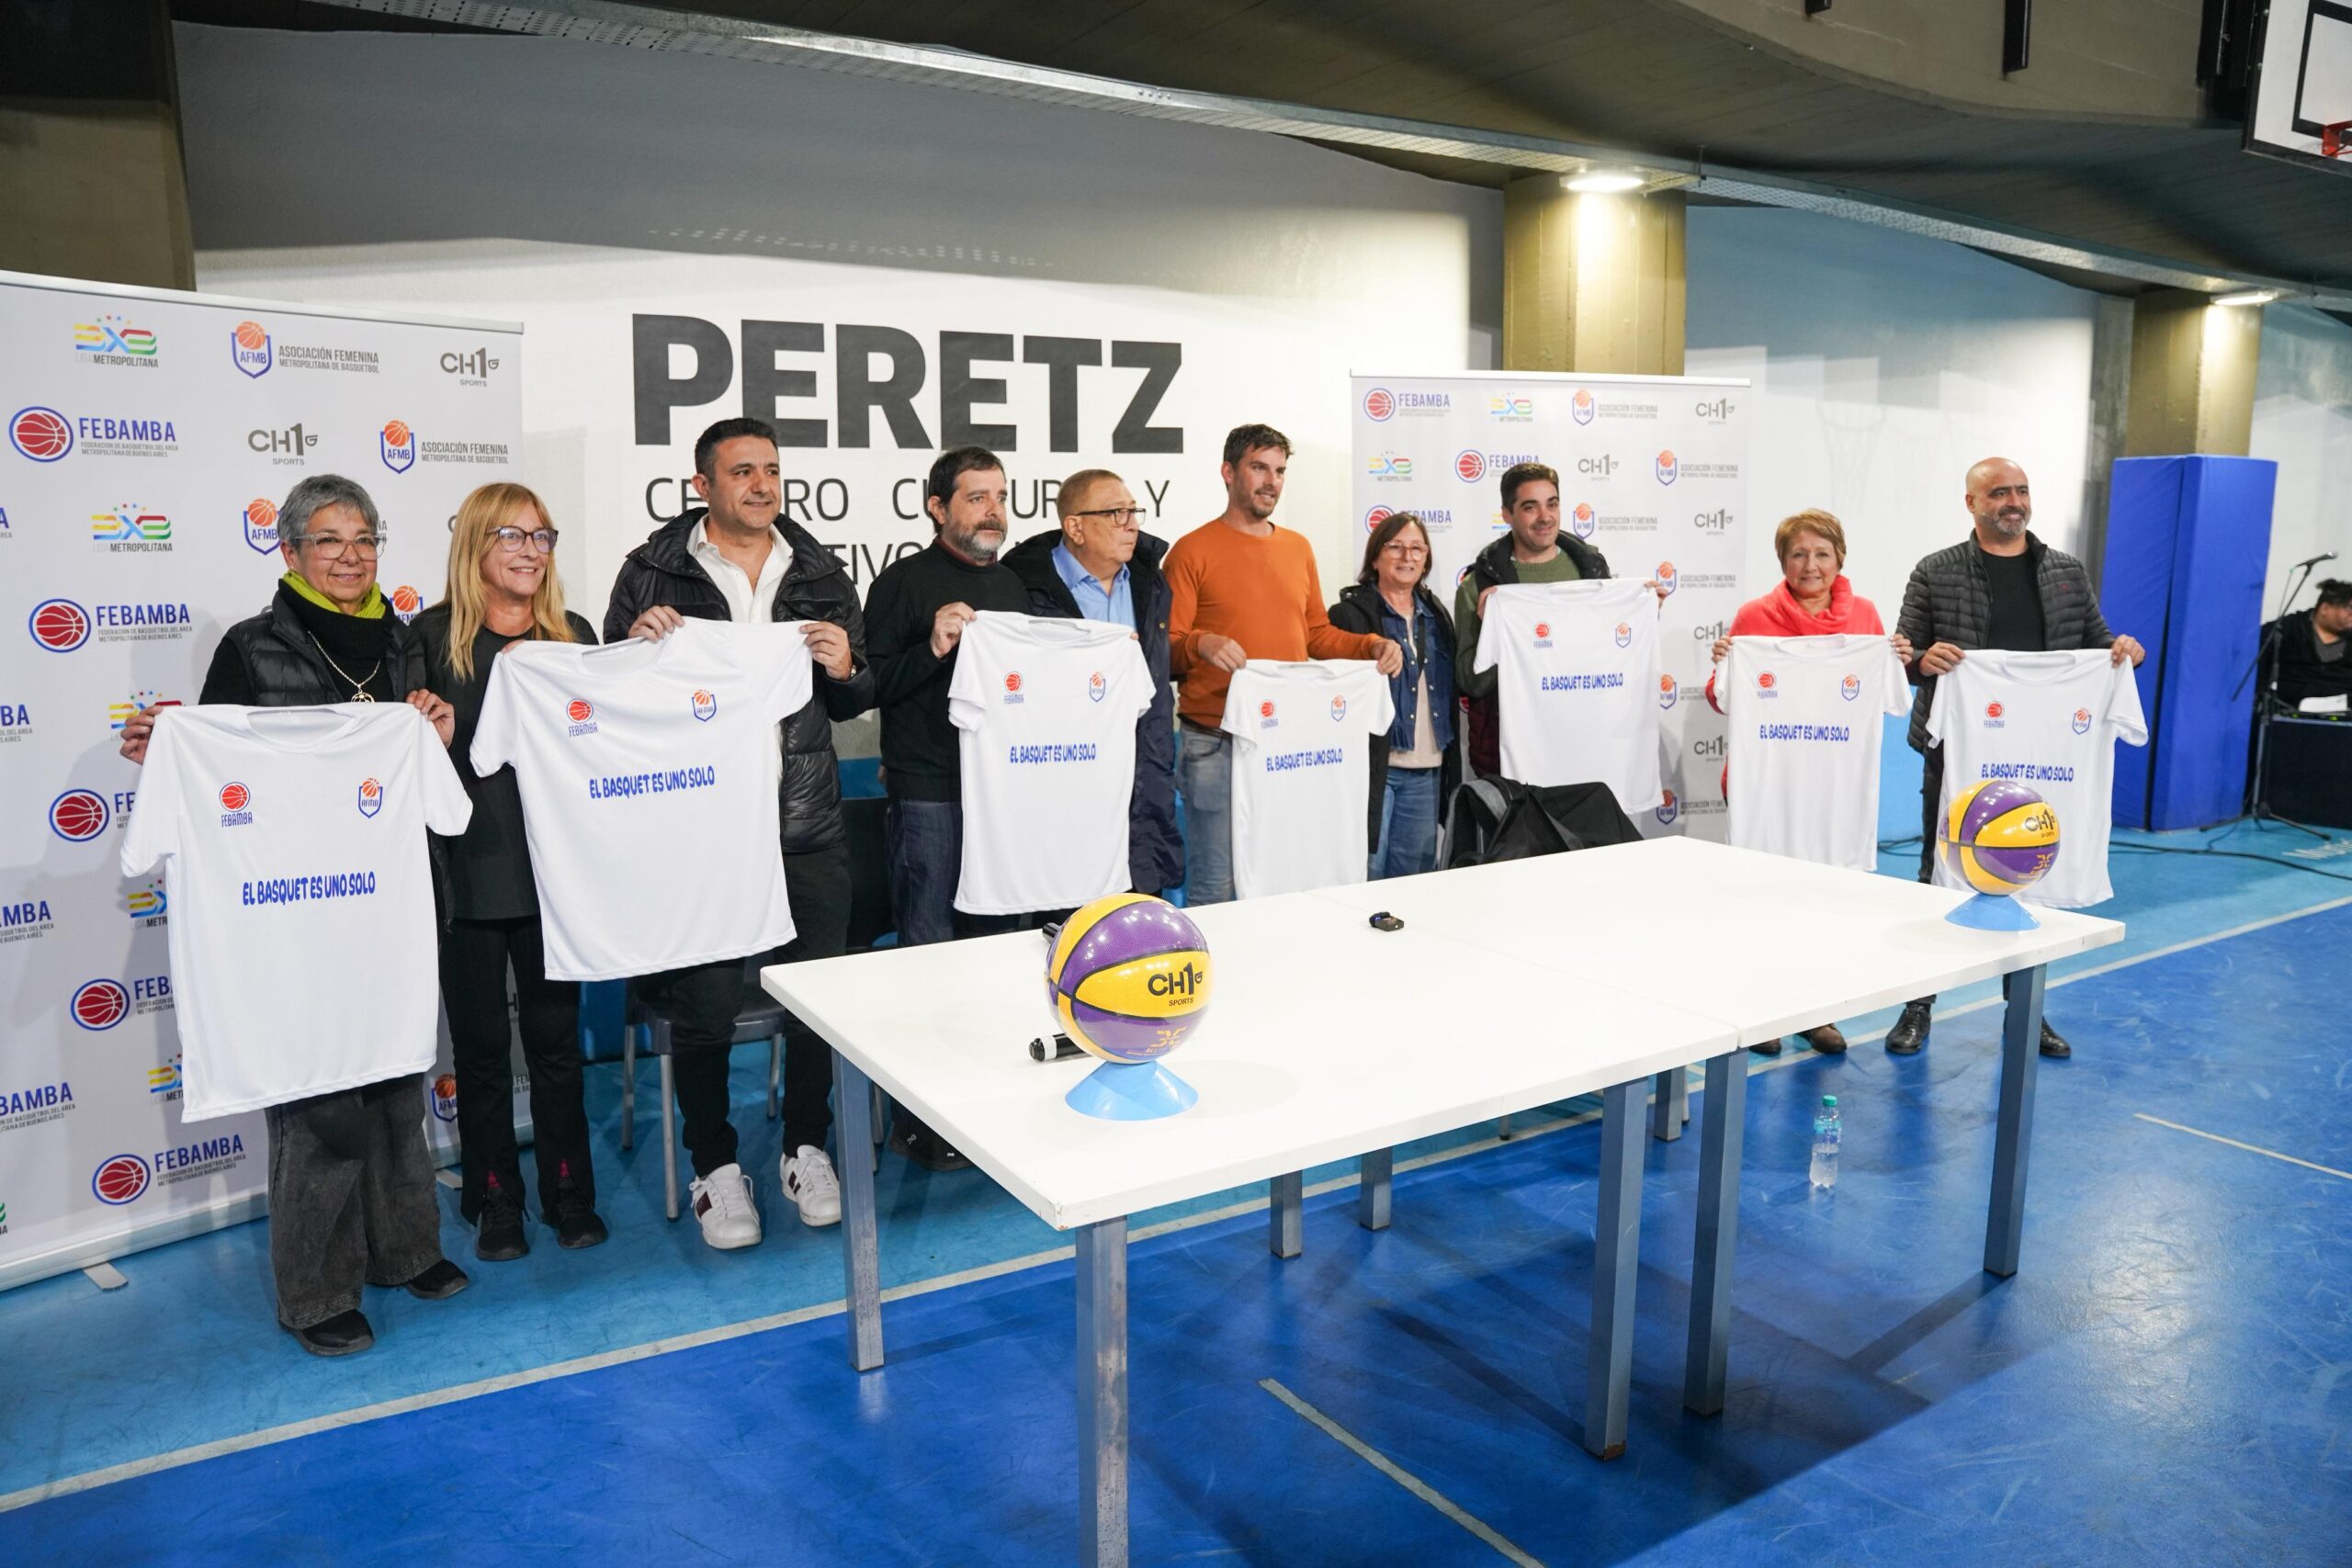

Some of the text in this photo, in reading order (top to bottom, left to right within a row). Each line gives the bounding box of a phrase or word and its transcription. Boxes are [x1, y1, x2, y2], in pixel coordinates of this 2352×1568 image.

[93, 355, 159, 367] METROPOLITANA
[240, 351, 267, 364] AFMB
[279, 345, 379, 364] ASOCIACIÓN FEMENINA
[279, 358, 380, 373] METROPOLITANA DE BASQUETBOL
[632, 313, 1184, 454] PERETZ
[1398, 393, 1450, 407] FEBAMBA
[79, 417, 175, 442] FEBAMBA
[387, 448, 411, 460] AFMB
[421, 441, 509, 455] ASOCIACIÓN FEMENINA
[273, 457, 305, 466] SPORTS
[1145, 479, 1170, 517] Y
[110, 542, 173, 552] METROPOLITANA
[96, 604, 190, 626] FEBAMBA
[1542, 672, 1623, 691] EL BASQUET ES UNO SOLO
[568, 722, 598, 737] FEBAMBA
[1759, 724, 1849, 741] EL BASQUET ES UNO SOLO
[1010, 743, 1096, 765] EL BASQUET ES UNO SOLO
[1266, 757, 1274, 772] EL
[1274, 752, 1305, 771] BASQUET
[1306, 751, 1313, 767] ES
[1326, 748, 1342, 764] SOLO
[1981, 763, 2075, 782] EL BASQUET ES UNO SOLO
[589, 765, 715, 799] EL BASQUET ES UNO SOLO
[220, 811, 253, 828] FEBAMBA
[243, 871, 376, 906] EL BASQUET ES UNO SOLO
[1169, 998, 1193, 1007] SPORTS
[154, 1134, 244, 1172] FEBAMBA
